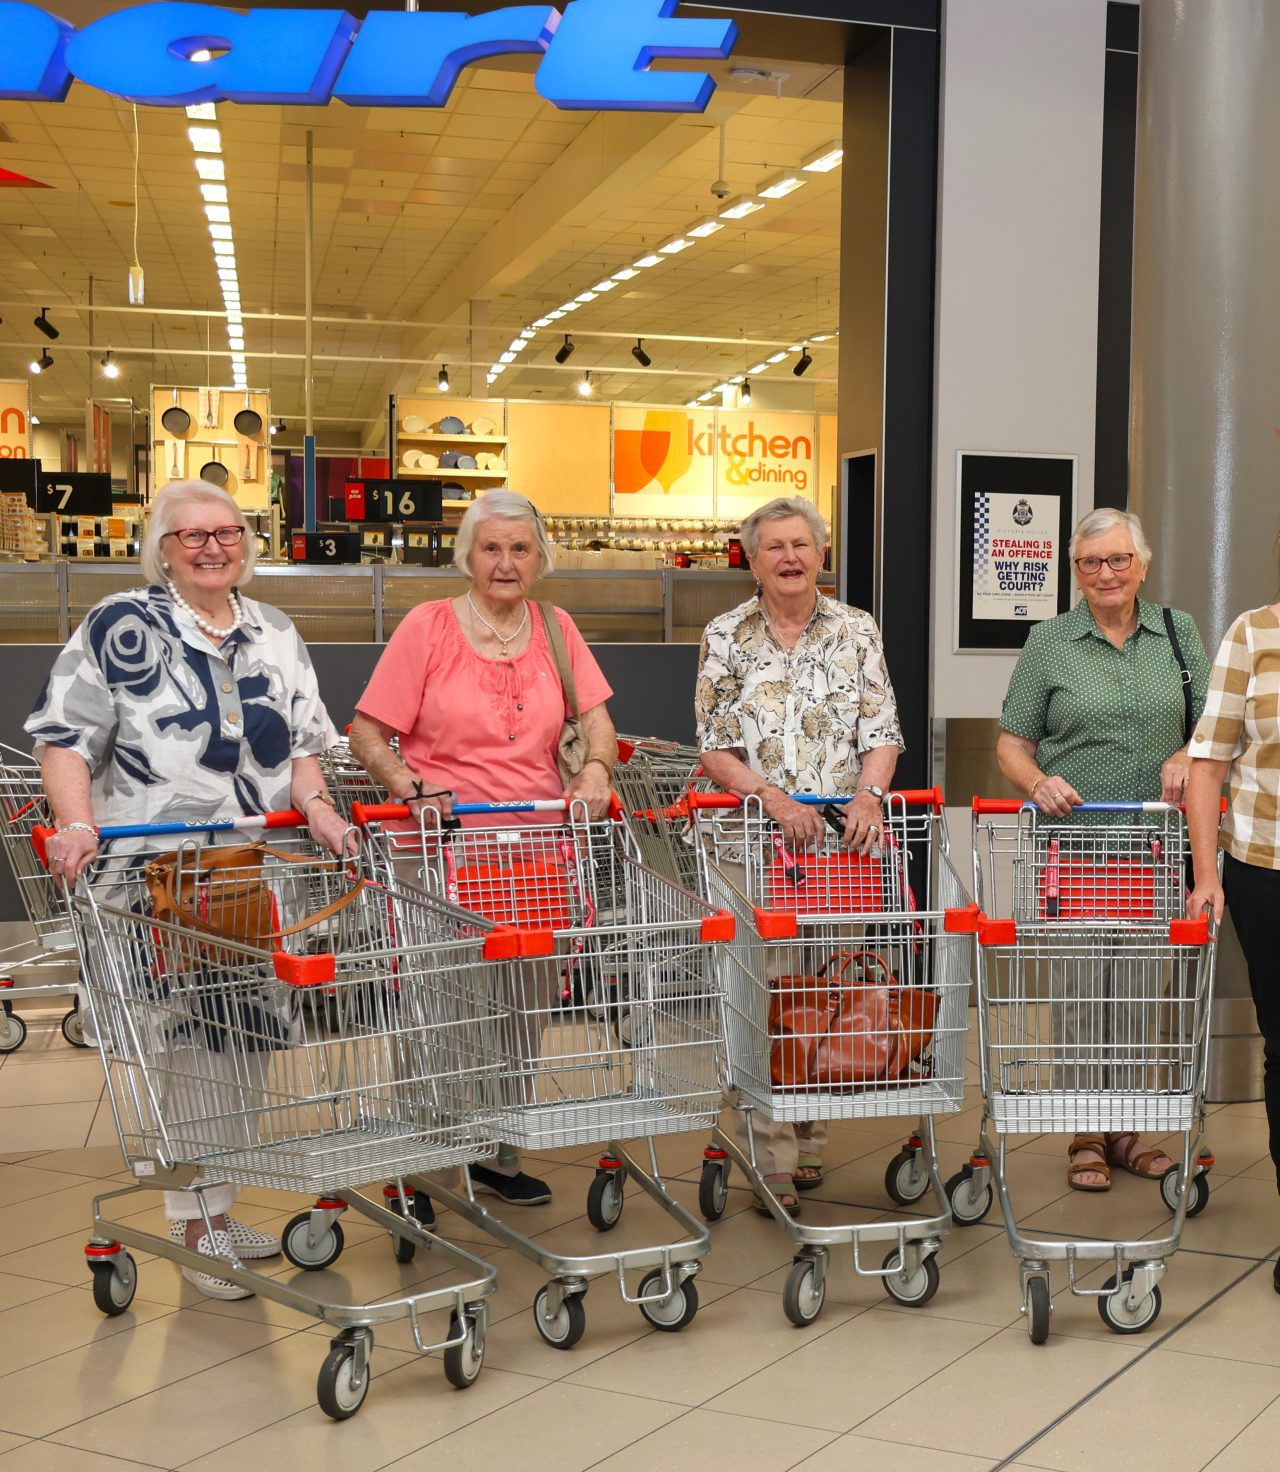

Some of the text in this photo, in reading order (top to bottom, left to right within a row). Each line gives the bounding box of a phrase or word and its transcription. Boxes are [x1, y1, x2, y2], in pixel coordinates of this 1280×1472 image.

[0, 0, 739, 112] art
[688, 419, 811, 459] kitchen
[725, 452, 807, 490] & dining
[47, 484, 73, 509] $7
[373, 490, 416, 515] $16
[320, 539, 337, 557] $3
[992, 539, 1052, 549] STEALING IS
[991, 549, 1053, 559] AN OFFENCE
[994, 561, 1049, 572] WHY RISK
[997, 571, 1046, 581] GETTING
[999, 581, 1044, 591] COURT?
